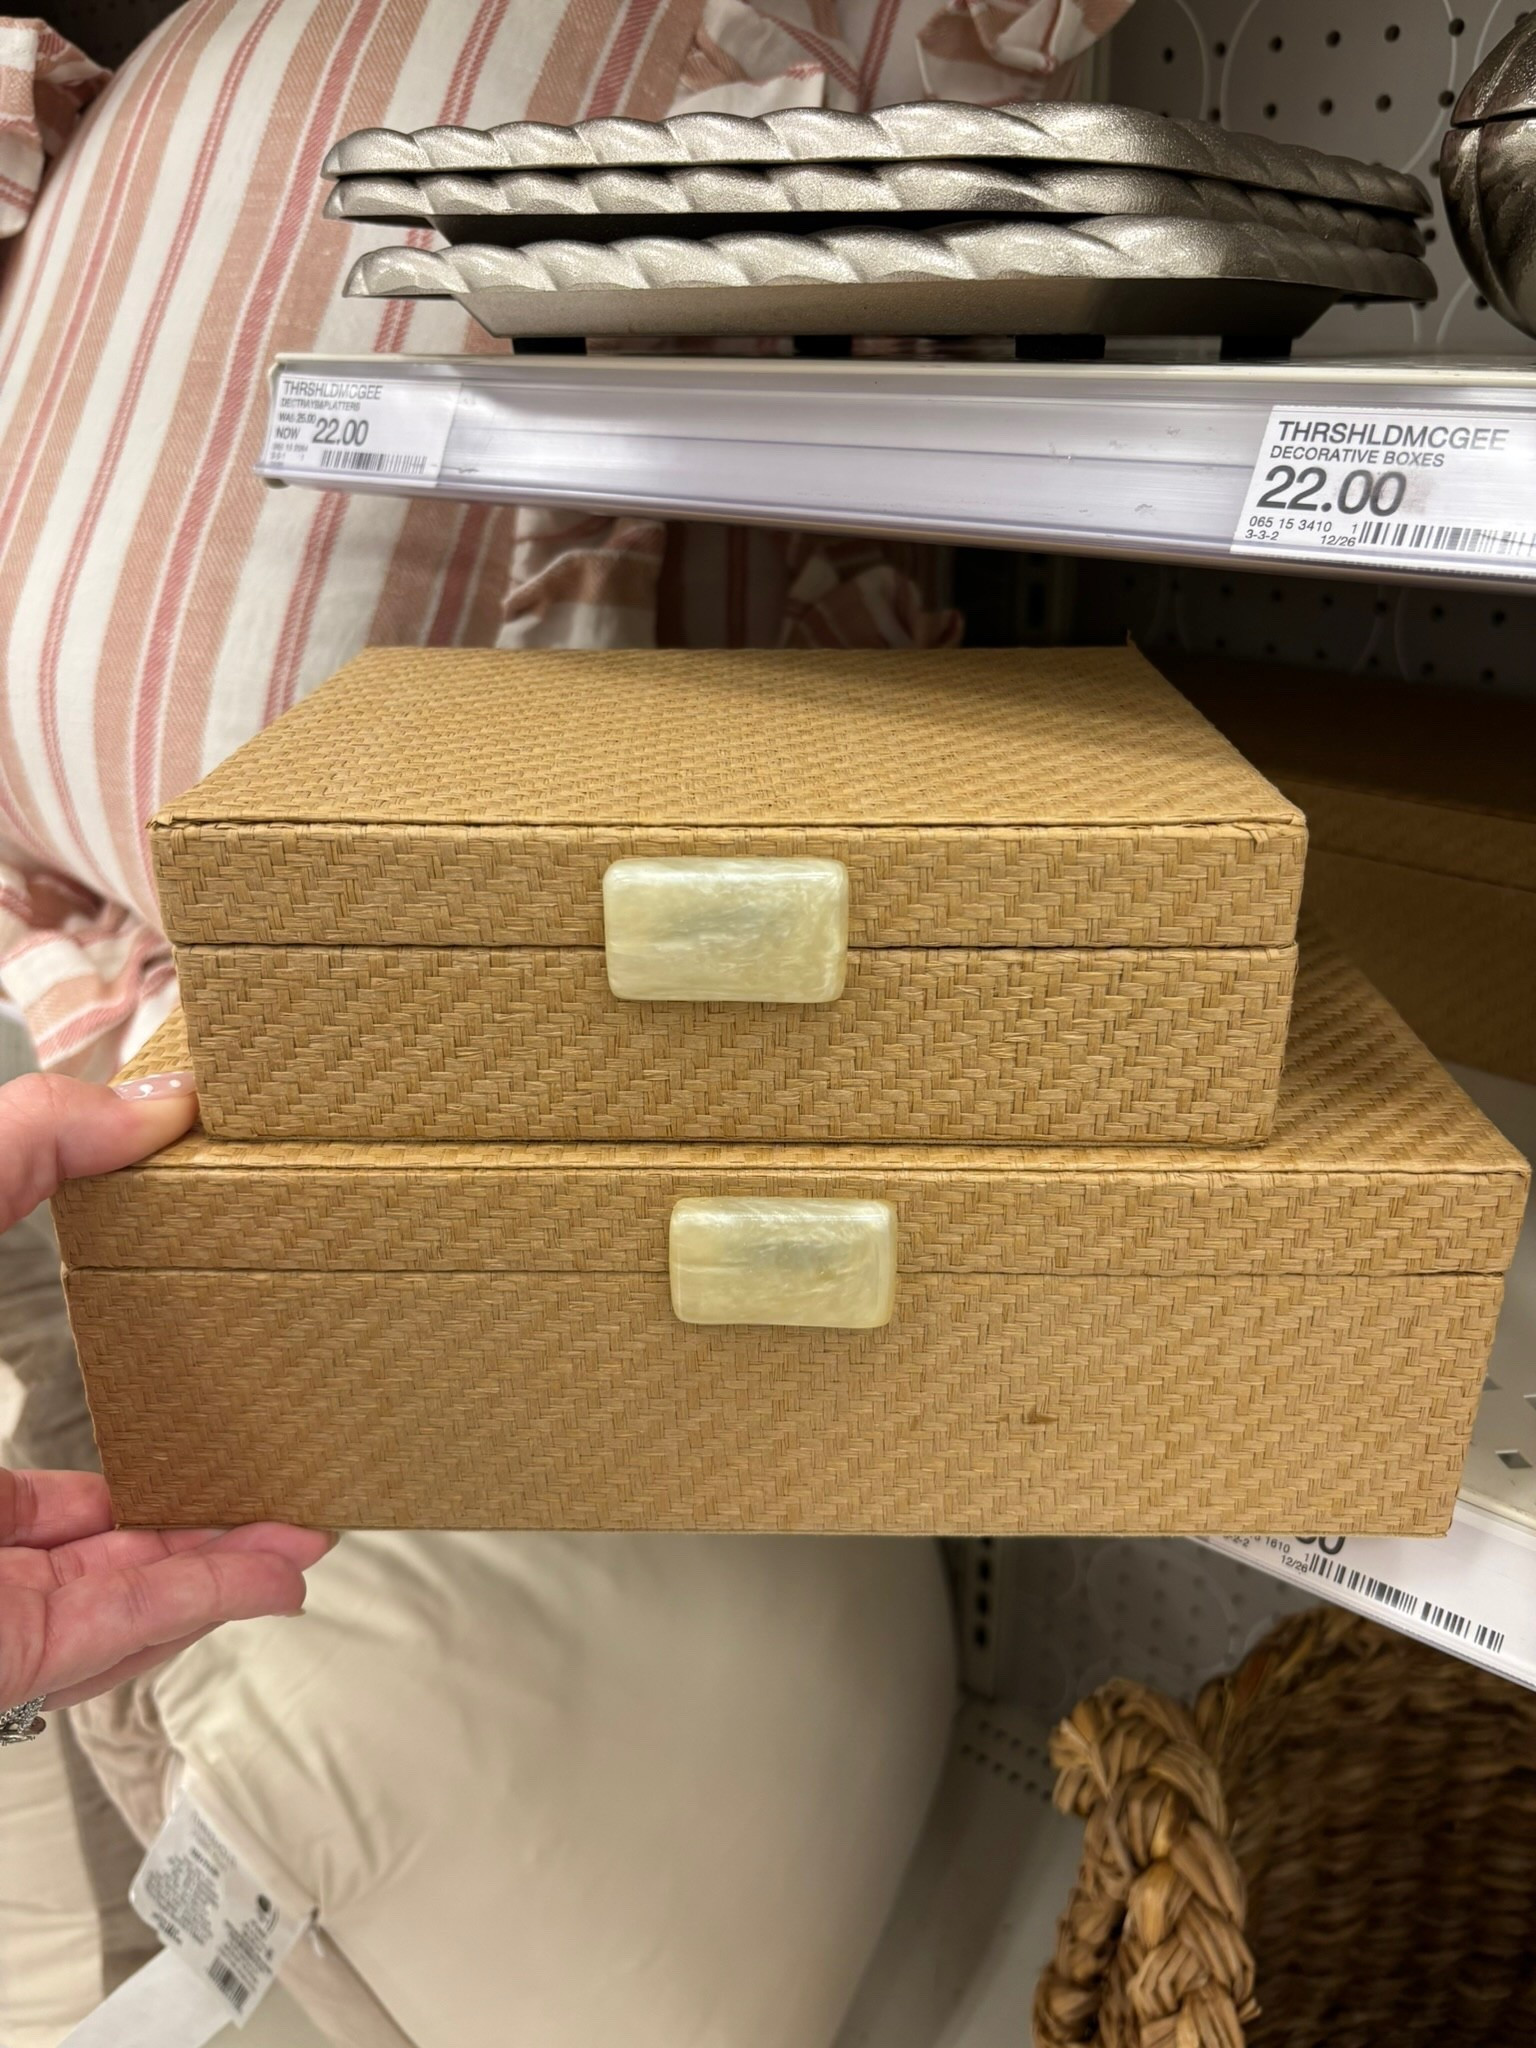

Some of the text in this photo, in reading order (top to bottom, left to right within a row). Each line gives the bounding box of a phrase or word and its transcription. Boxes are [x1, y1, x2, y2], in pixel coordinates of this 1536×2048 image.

[283, 380, 383, 400] THRSHLDMCGEE
[276, 417, 369, 446] NOW 22.00
[1278, 420, 1510, 451] THRSHLDMCGEE
[1270, 445, 1446, 468] DECORATIVE BOXES
[1256, 465, 1407, 517] 22.00
[1249, 516, 1273, 528] 065
[1279, 518, 1294, 529] 15
[1298, 519, 1332, 532] 3410
[1245, 529, 1356, 547] 3-3-2 12/26
[1266, 1537, 1290, 1554] 1610
[1281, 1554, 1308, 1573] 12/26
